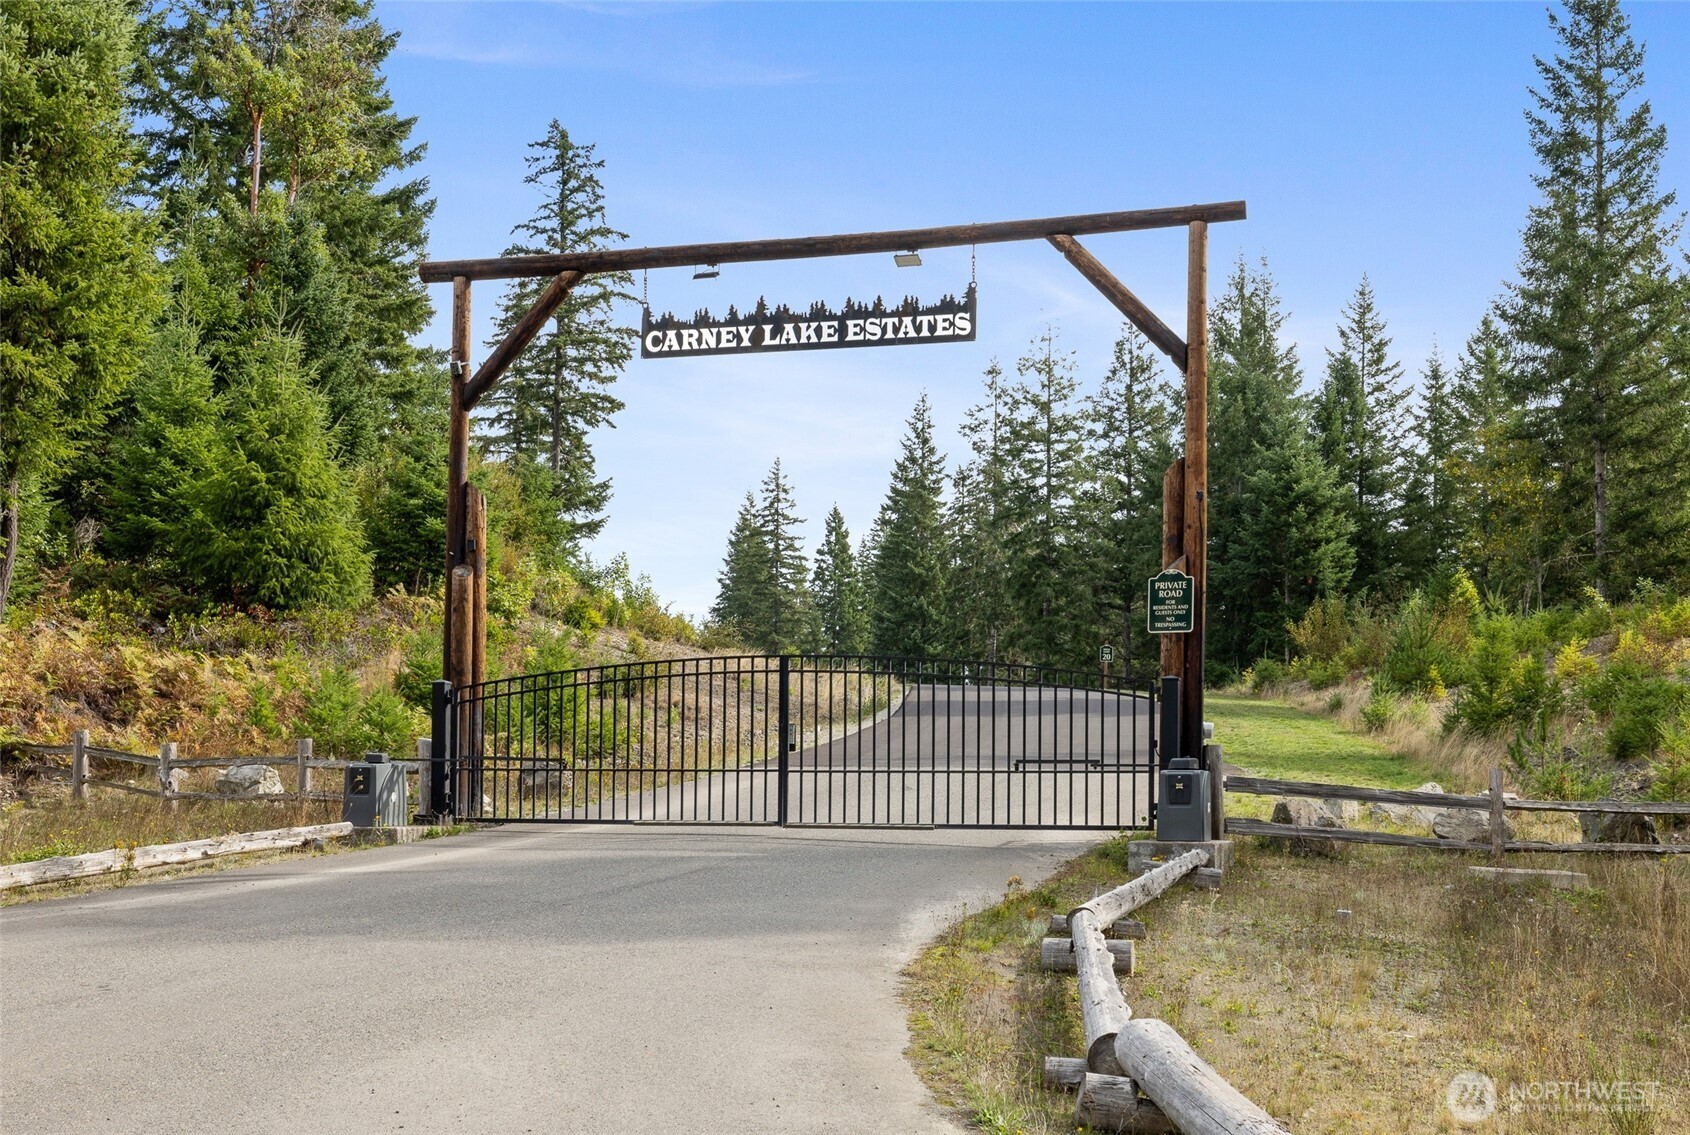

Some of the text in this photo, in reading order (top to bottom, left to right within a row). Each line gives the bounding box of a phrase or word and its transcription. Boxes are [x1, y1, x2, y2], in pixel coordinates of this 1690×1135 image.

[645, 312, 972, 353] CARNEY LAKE ESTATES
[1155, 581, 1187, 589] PRIVATE
